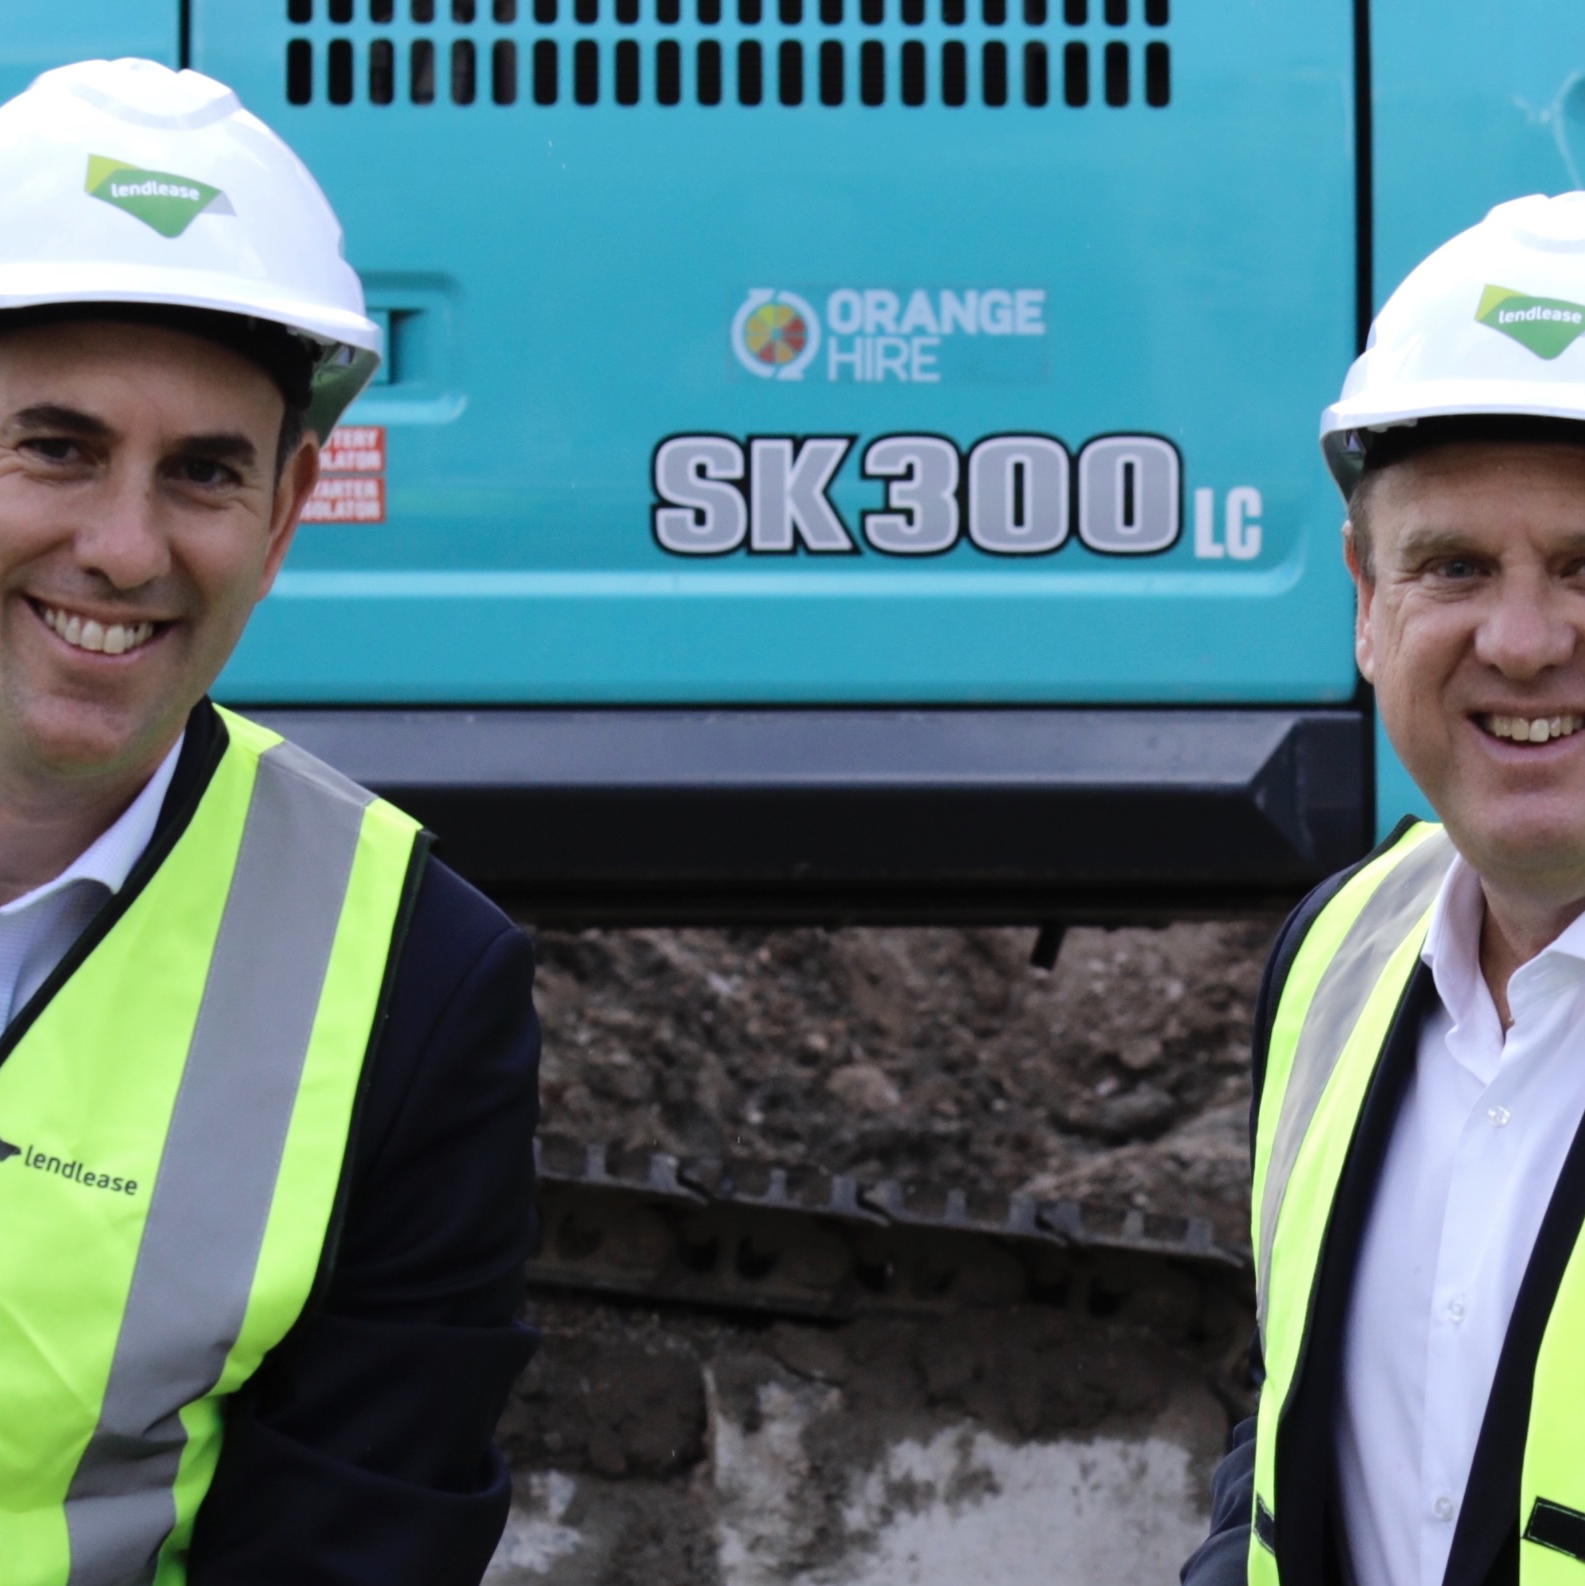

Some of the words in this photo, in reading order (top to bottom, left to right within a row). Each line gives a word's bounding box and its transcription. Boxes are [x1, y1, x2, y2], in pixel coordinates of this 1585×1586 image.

[110, 181, 200, 201] lendlease
[827, 289, 1045, 335] ORANGE
[1498, 305, 1582, 325] lendlease
[827, 337, 941, 382] HIRE
[651, 433, 1183, 556] SK300
[1193, 487, 1261, 560] LC
[25, 1144, 138, 1196] lendlease
